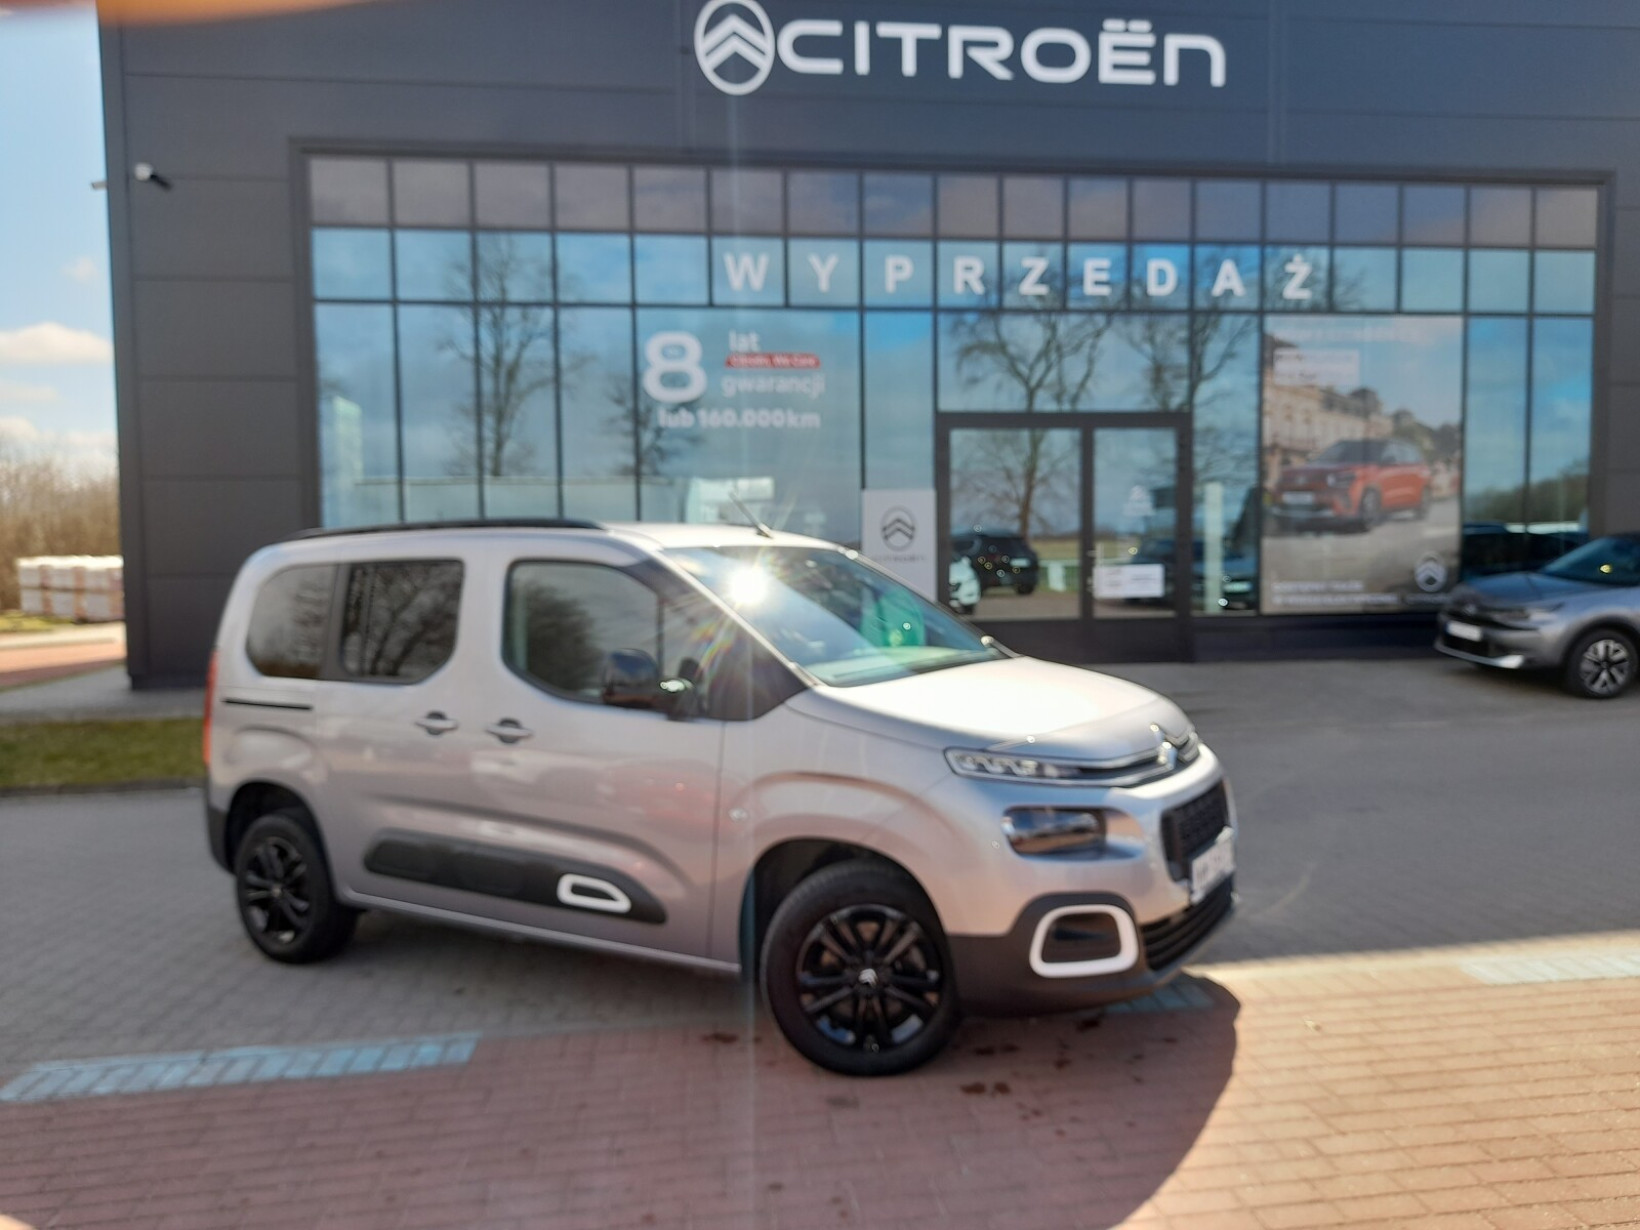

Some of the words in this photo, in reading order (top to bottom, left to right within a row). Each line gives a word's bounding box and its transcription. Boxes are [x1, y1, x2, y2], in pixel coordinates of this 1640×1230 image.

[724, 252, 1312, 300] WYPRZEDAŻ
[728, 330, 760, 350] lat
[643, 331, 707, 402] 8
[722, 375, 825, 397] gwarancji
[657, 408, 693, 428] lub
